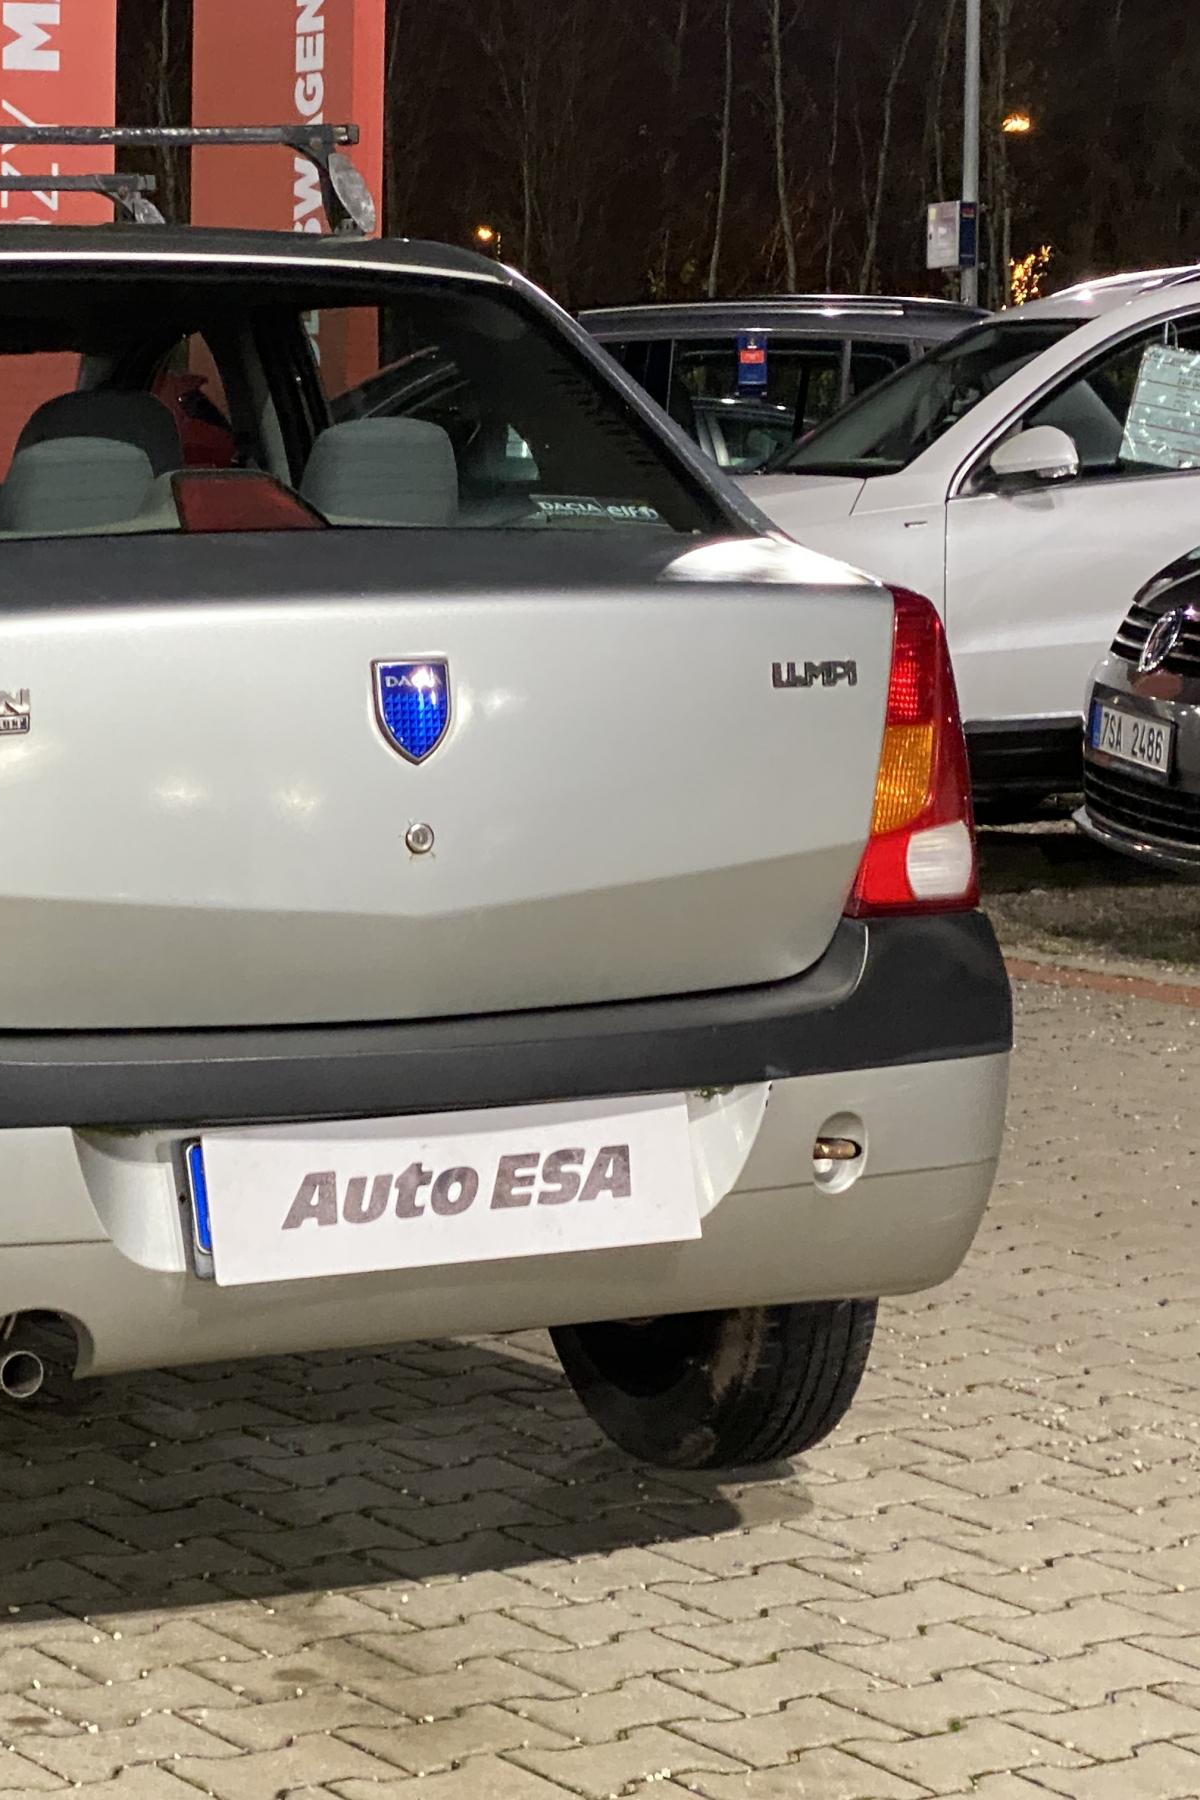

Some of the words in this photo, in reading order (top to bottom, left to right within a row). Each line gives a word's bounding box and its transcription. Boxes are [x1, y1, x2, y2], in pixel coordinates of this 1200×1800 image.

[2, 0, 60, 72] M
[1101, 711, 1123, 752] 7SA
[1131, 722, 1164, 764] 2486
[490, 1143, 632, 1210] ESA
